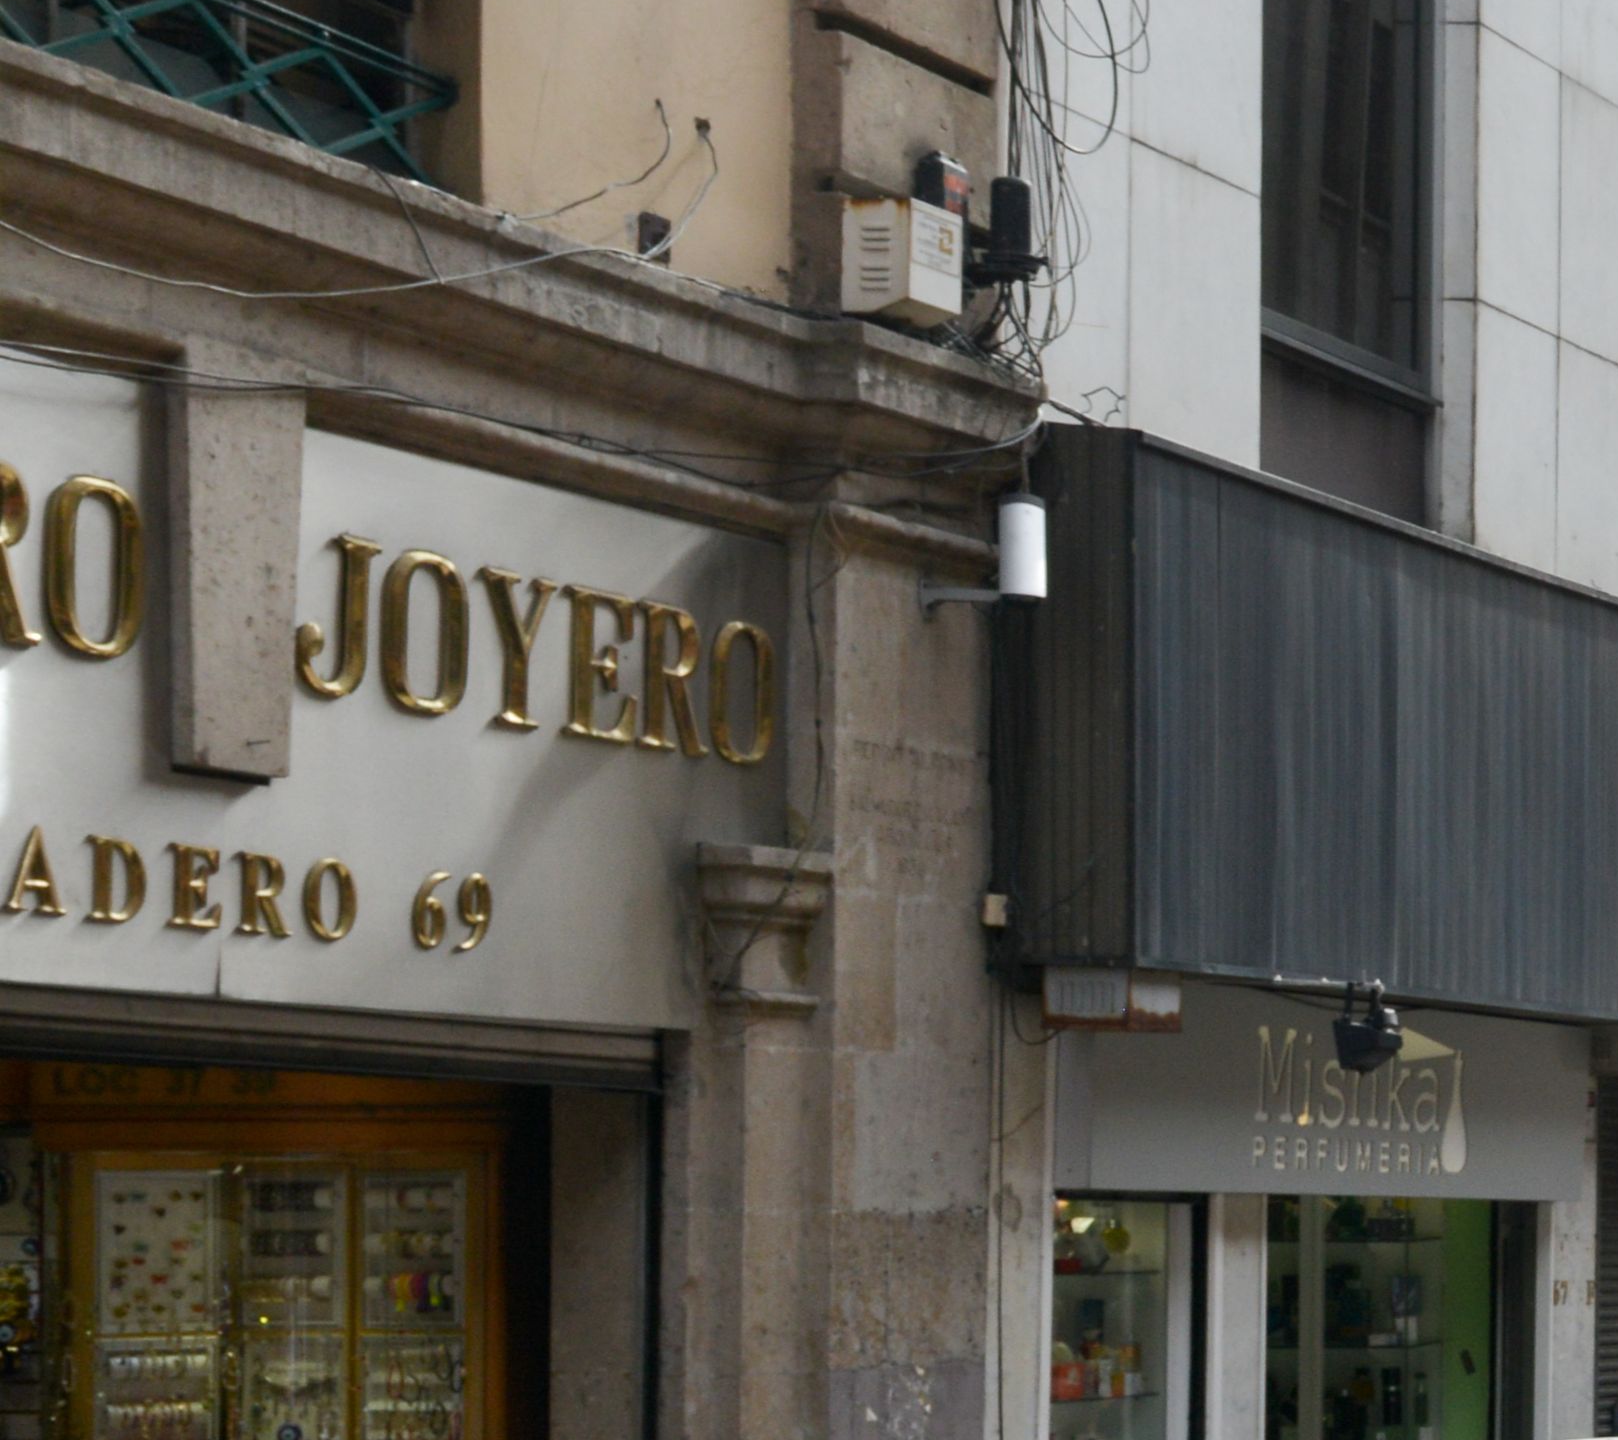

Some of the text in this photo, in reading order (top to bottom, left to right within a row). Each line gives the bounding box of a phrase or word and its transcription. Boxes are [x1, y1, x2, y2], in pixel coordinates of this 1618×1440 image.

[296, 532, 776, 765] JOYERO
[3, 824, 493, 954] ADERO 69
[1252, 1135, 1441, 1175] PERFUMERIA
